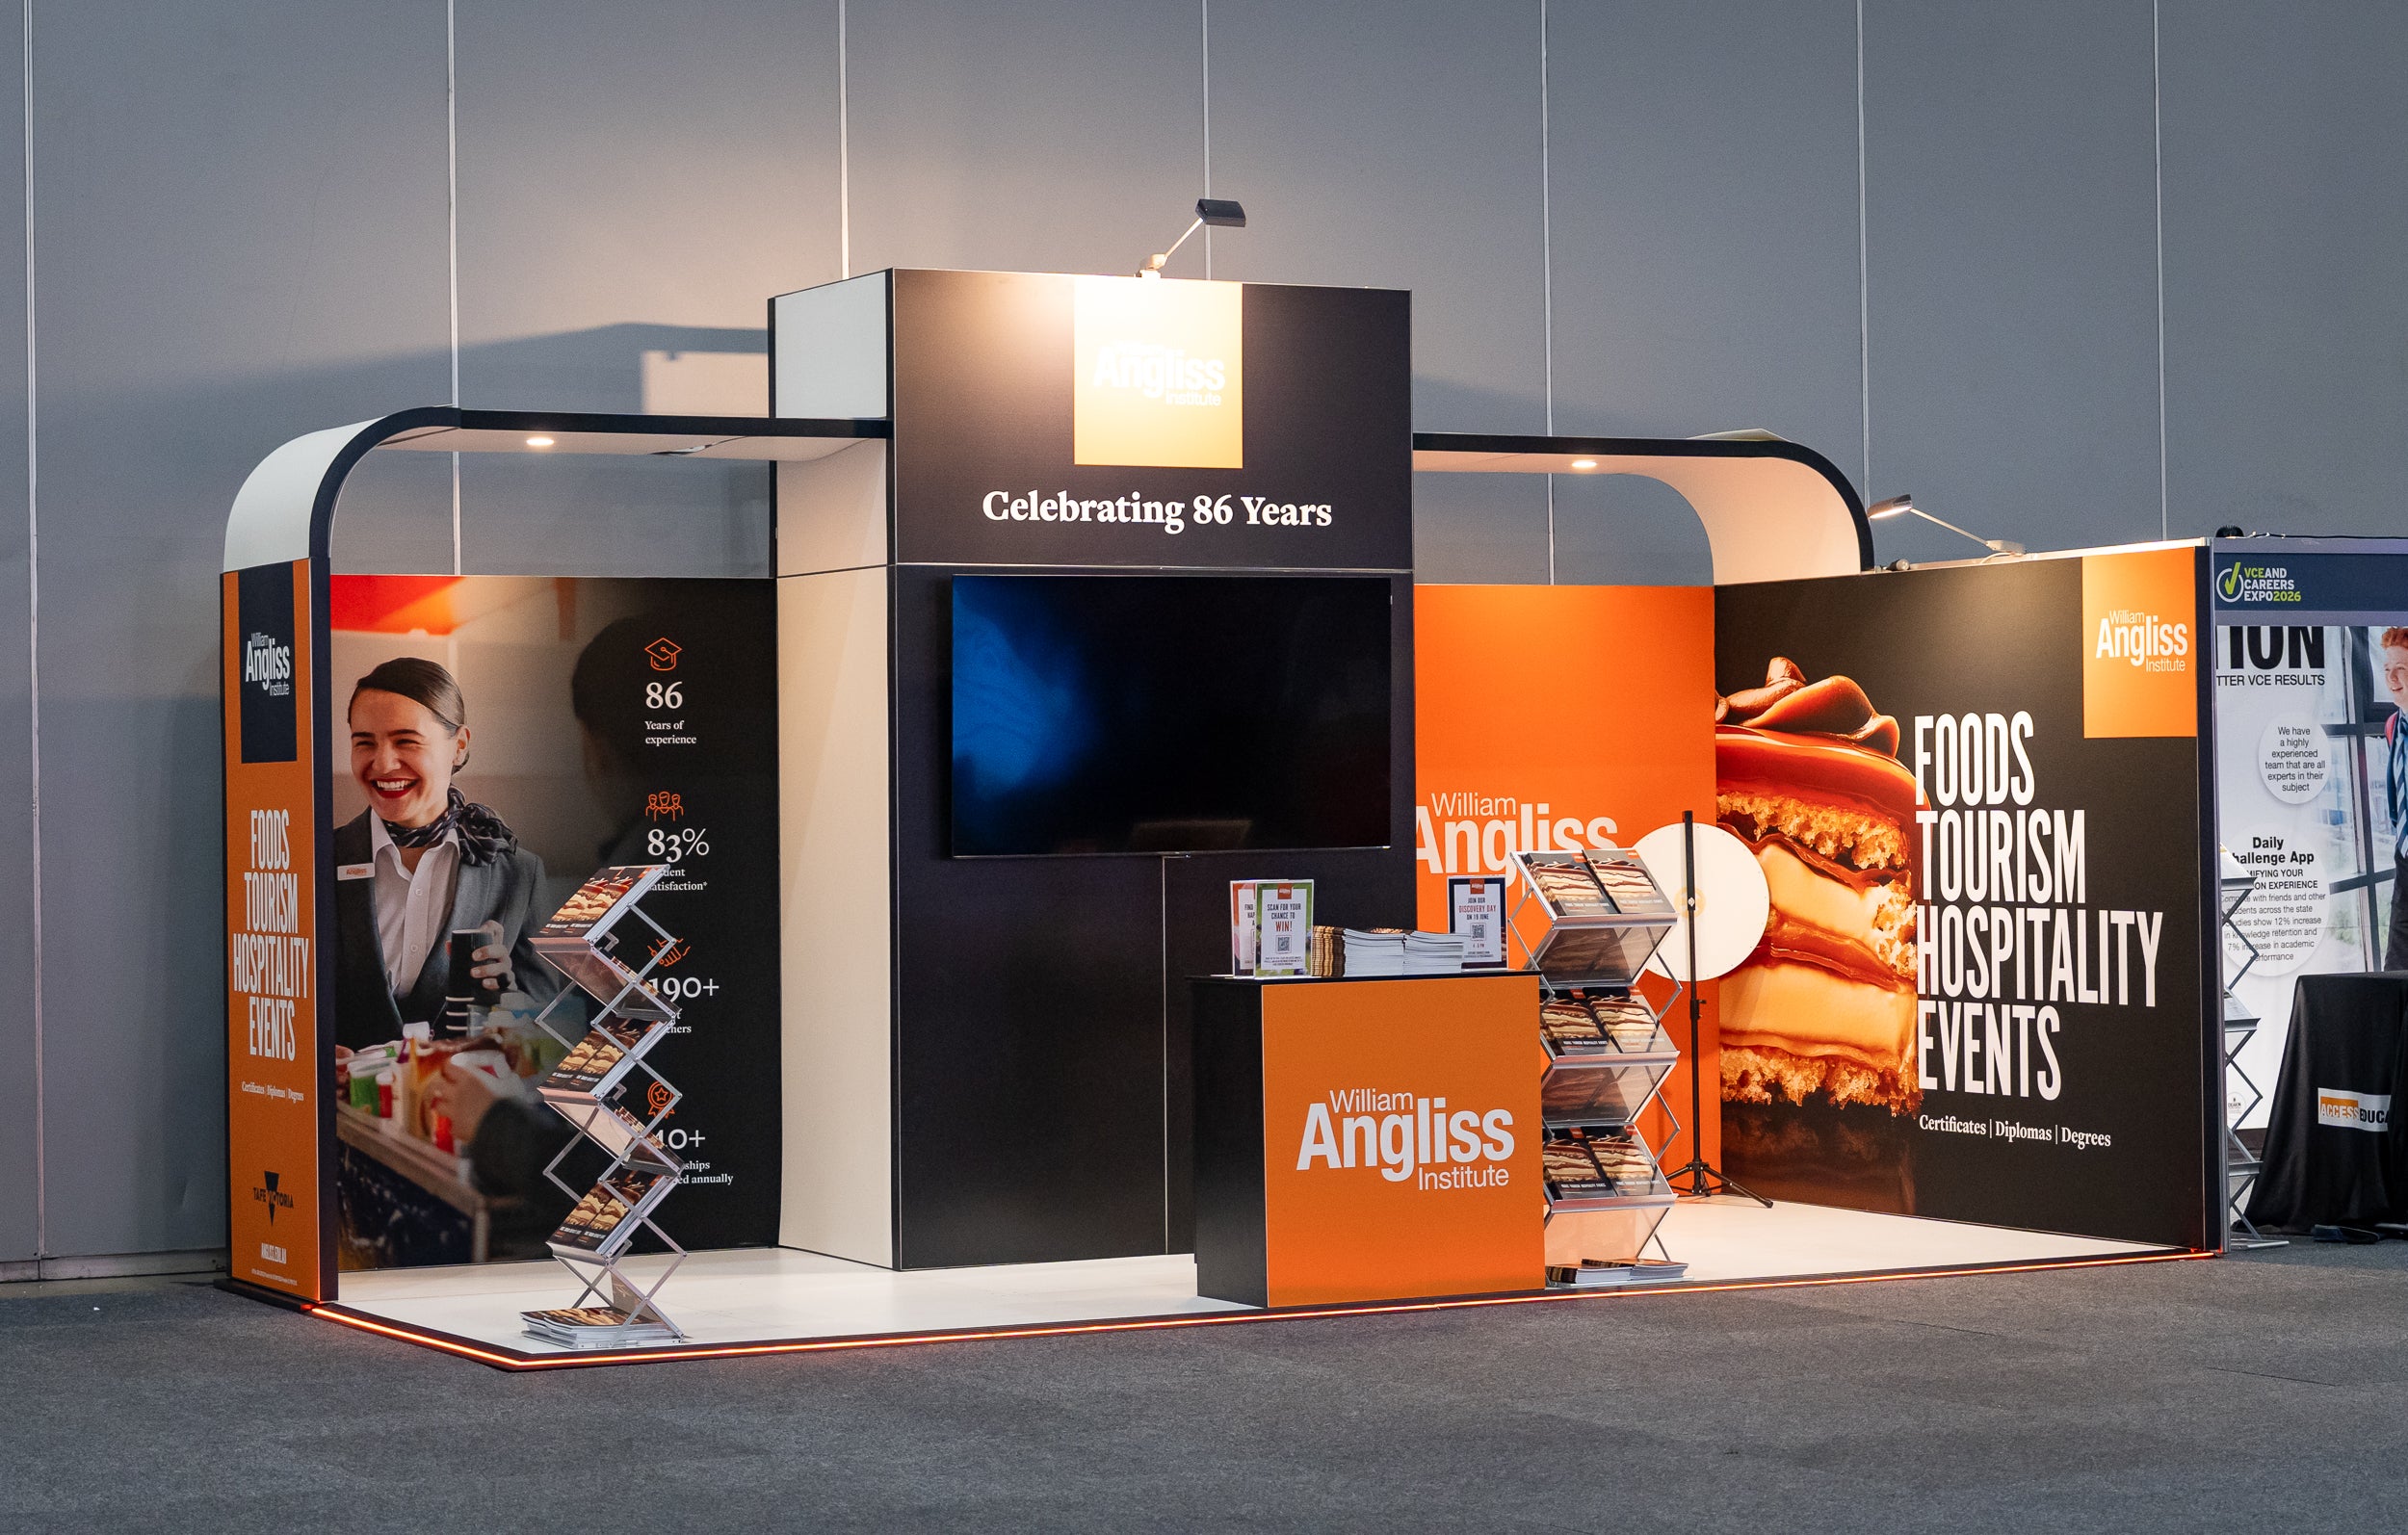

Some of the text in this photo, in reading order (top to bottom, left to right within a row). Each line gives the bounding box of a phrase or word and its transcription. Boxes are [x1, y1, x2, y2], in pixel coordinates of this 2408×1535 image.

[1092, 345, 1226, 399] Angliss
[1165, 390, 1222, 406] Institute
[982, 489, 1333, 534] Celebrating 86 Years
[2244, 579, 2295, 590] CAREERS
[2244, 590, 2302, 602] EXPO2026
[2108, 610, 2145, 625] William
[2095, 614, 2188, 667] Angliss
[2215, 626, 2325, 670] ION
[245, 637, 290, 691] Angliss
[2146, 657, 2186, 672] Institute
[2216, 674, 2325, 687] TTER VCE RESULTS
[645, 681, 684, 710] 86
[644, 719, 685, 731] Years of
[2277, 726, 2311, 736] We have
[645, 734, 696, 746] experience
[2287, 738, 2310, 748] highly
[1914, 710, 2035, 807] FOODS
[2271, 748, 2318, 759] experienced
[2264, 761, 2284, 769] team
[2286, 760, 2301, 769] that
[2316, 760, 2326, 769] all
[2267, 770, 2324, 782] experts in their
[2282, 782, 2310, 793] subject
[1431, 792, 1517, 818] William
[250, 808, 290, 872] FOODS
[647, 828, 710, 863] 83%
[2252, 836, 2284, 850] Daily
[1915, 808, 2086, 904] TOURISM
[2232, 850, 2315, 866] hallenge App
[2280, 869, 2303, 877] YOUR
[2268, 880, 2318, 889] EXPERIENCE
[244, 872, 299, 934] TOURISM
[2253, 894, 2267, 902] with
[2268, 893, 2291, 901] friends
[2293, 893, 2307, 901] and
[2283, 905, 2294, 914] the
[1275, 921, 1293, 932] WIN!
[2274, 917, 2290, 925] 12%
[2271, 928, 2303, 937] retention
[2304, 927, 2317, 936] and
[2228, 943, 2240, 951] 7%
[2280, 940, 2315, 949] academic
[1916, 904, 2163, 1007] HOSPITALITY
[233, 932, 309, 999] HOSPITALITY
[249, 996, 296, 1061] EVENTS
[1917, 999, 2062, 1101] EVENTS
[1329, 1088, 1414, 1113] William
[1919, 1113, 2111, 1150] Certificates Diplomas Degrees
[1296, 1097, 1515, 1182] Angliss
[691, 1173, 734, 1185] annually
[1418, 1164, 1509, 1190] Institute
[253, 1186, 267, 1203] TAFE
